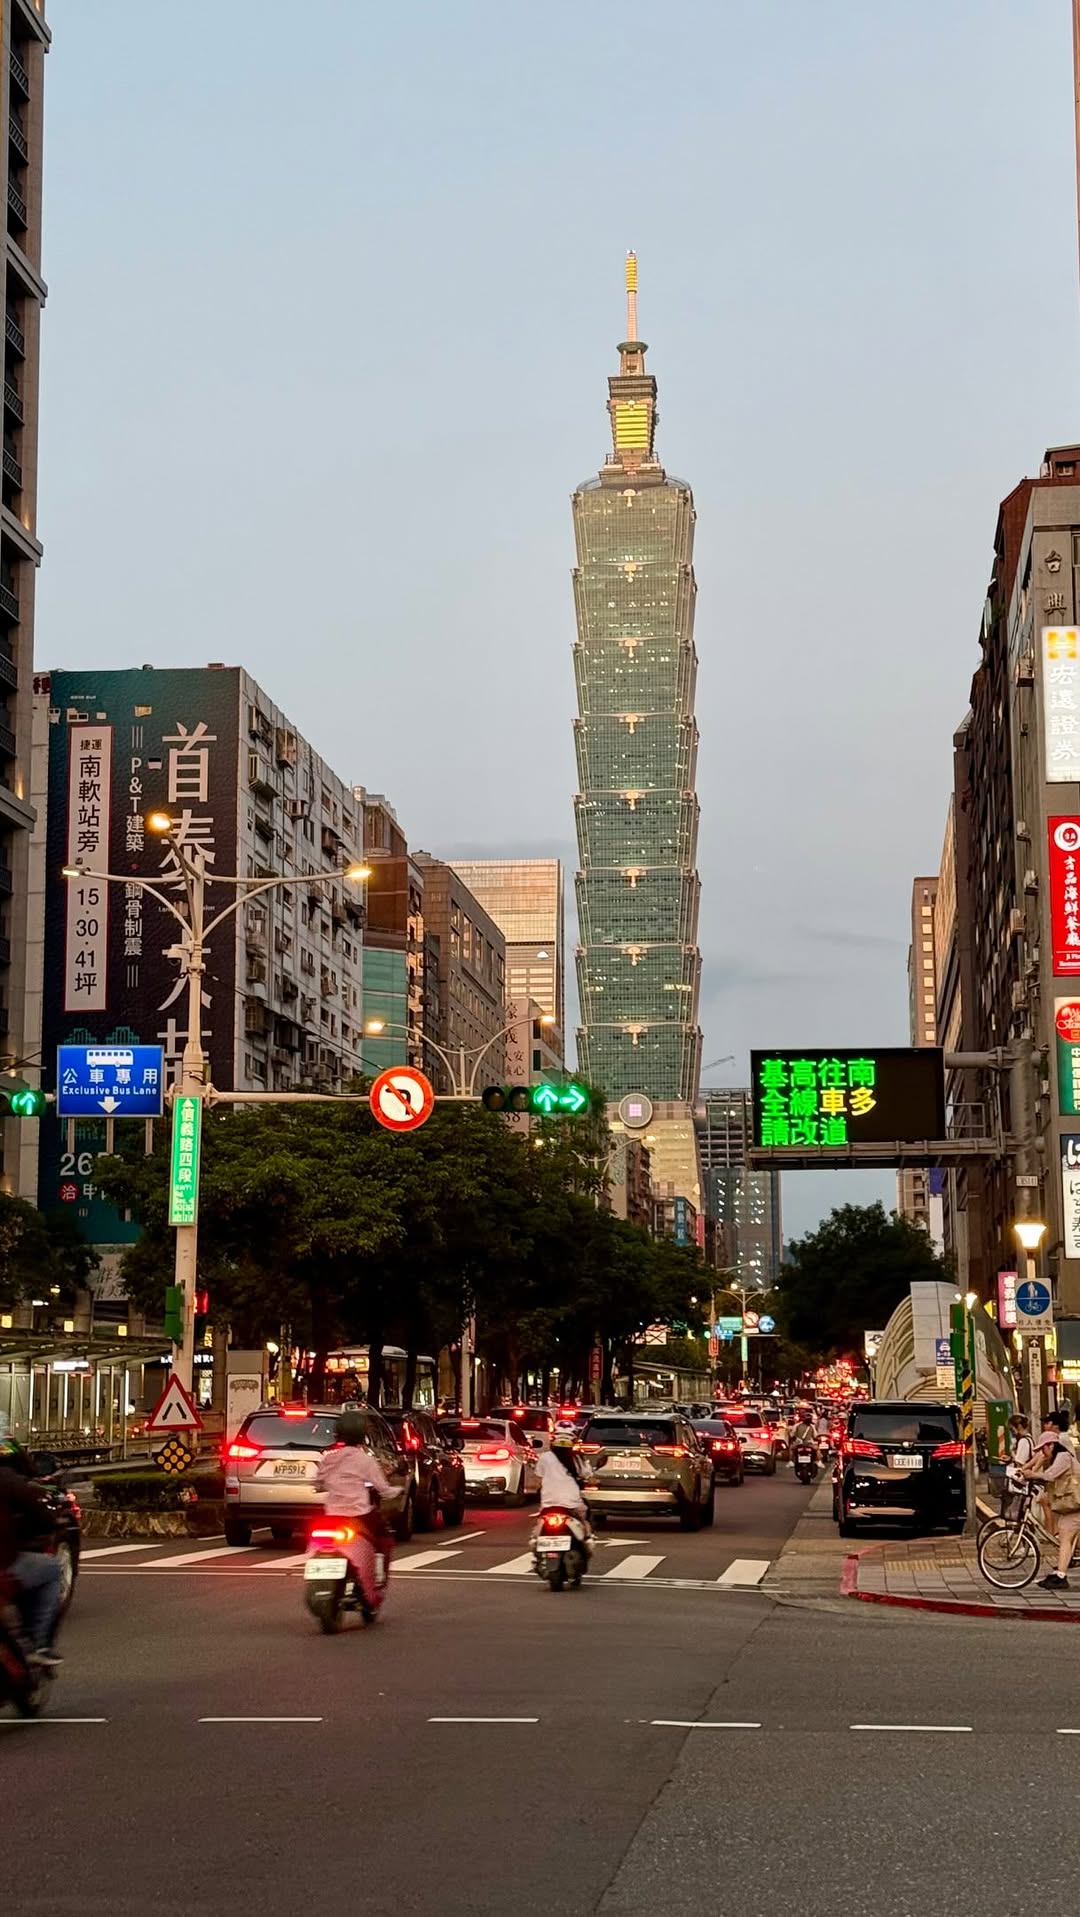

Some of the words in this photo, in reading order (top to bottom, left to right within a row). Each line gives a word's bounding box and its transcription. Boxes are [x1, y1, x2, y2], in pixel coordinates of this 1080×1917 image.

[80, 738, 102, 751] 捷運
[77, 754, 102, 853] 南軟站旁
[124, 881, 143, 956] 鋼骨制震
[63, 1068, 158, 1085] 公車專用
[760, 1057, 876, 1087] 基高往南
[62, 1086, 110, 1096] Exclusive
[112, 1086, 130, 1096] Bus
[132, 1086, 157, 1096] Lane
[760, 1087, 877, 1117] 全線車多
[178, 1108, 196, 1183] 信義路四段
[760, 1117, 849, 1146] 請改道
